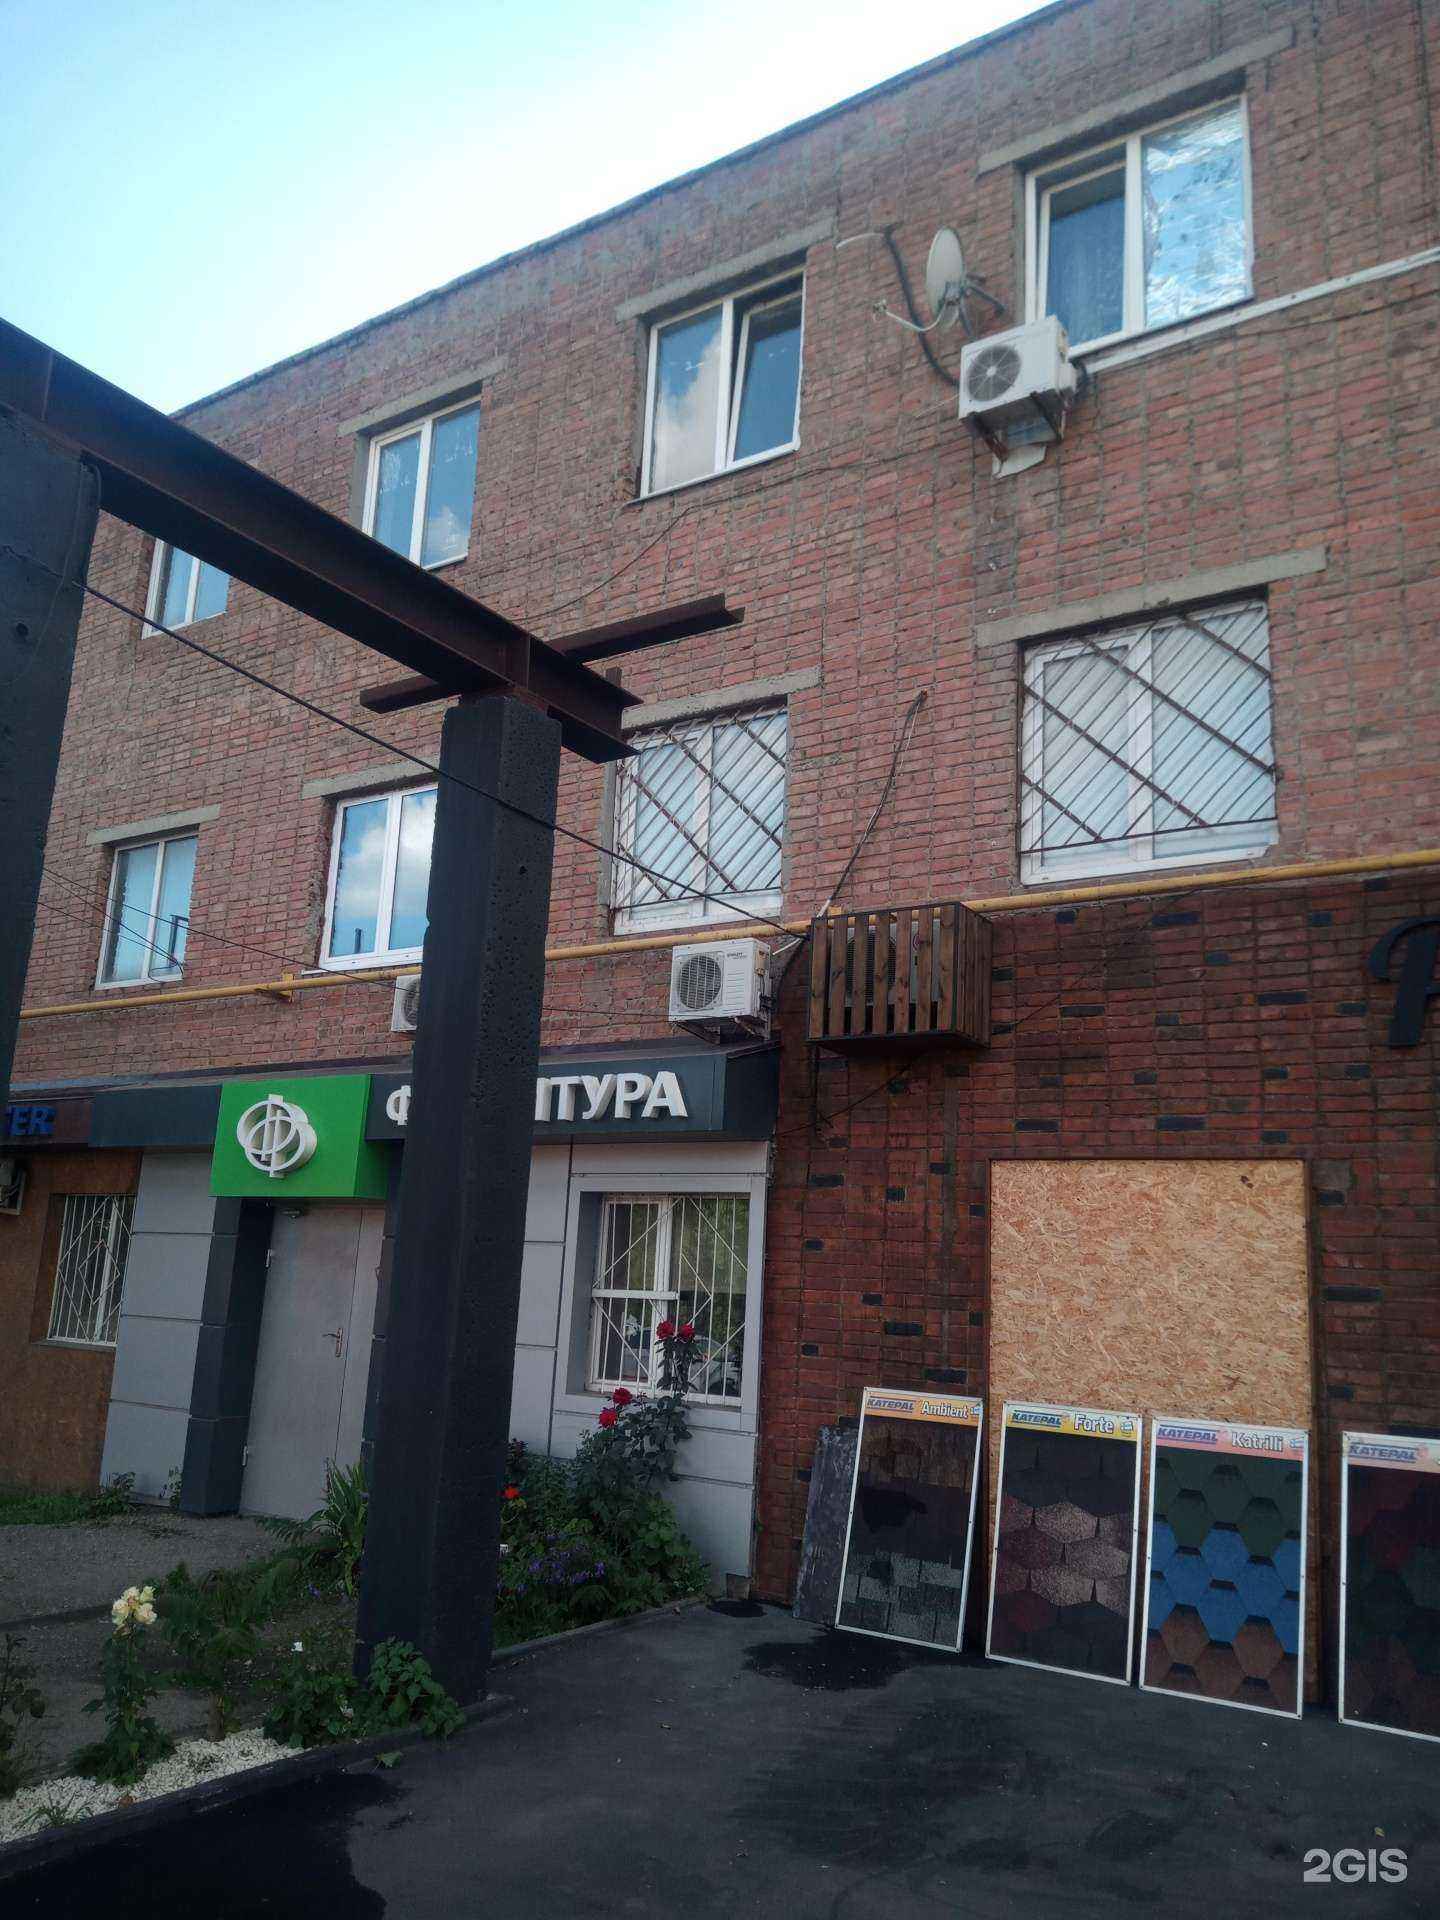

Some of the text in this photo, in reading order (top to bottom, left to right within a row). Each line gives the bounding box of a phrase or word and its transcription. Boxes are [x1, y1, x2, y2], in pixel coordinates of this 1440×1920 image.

[385, 1070, 688, 1126] ФТУРА
[866, 1398, 969, 1419] KATEPAL Ambient
[1012, 1411, 1115, 1434] KATEPAL Forte
[1157, 1427, 1284, 1452] KATEPAL Katrilli
[1349, 1444, 1419, 1461] KATEPAL
